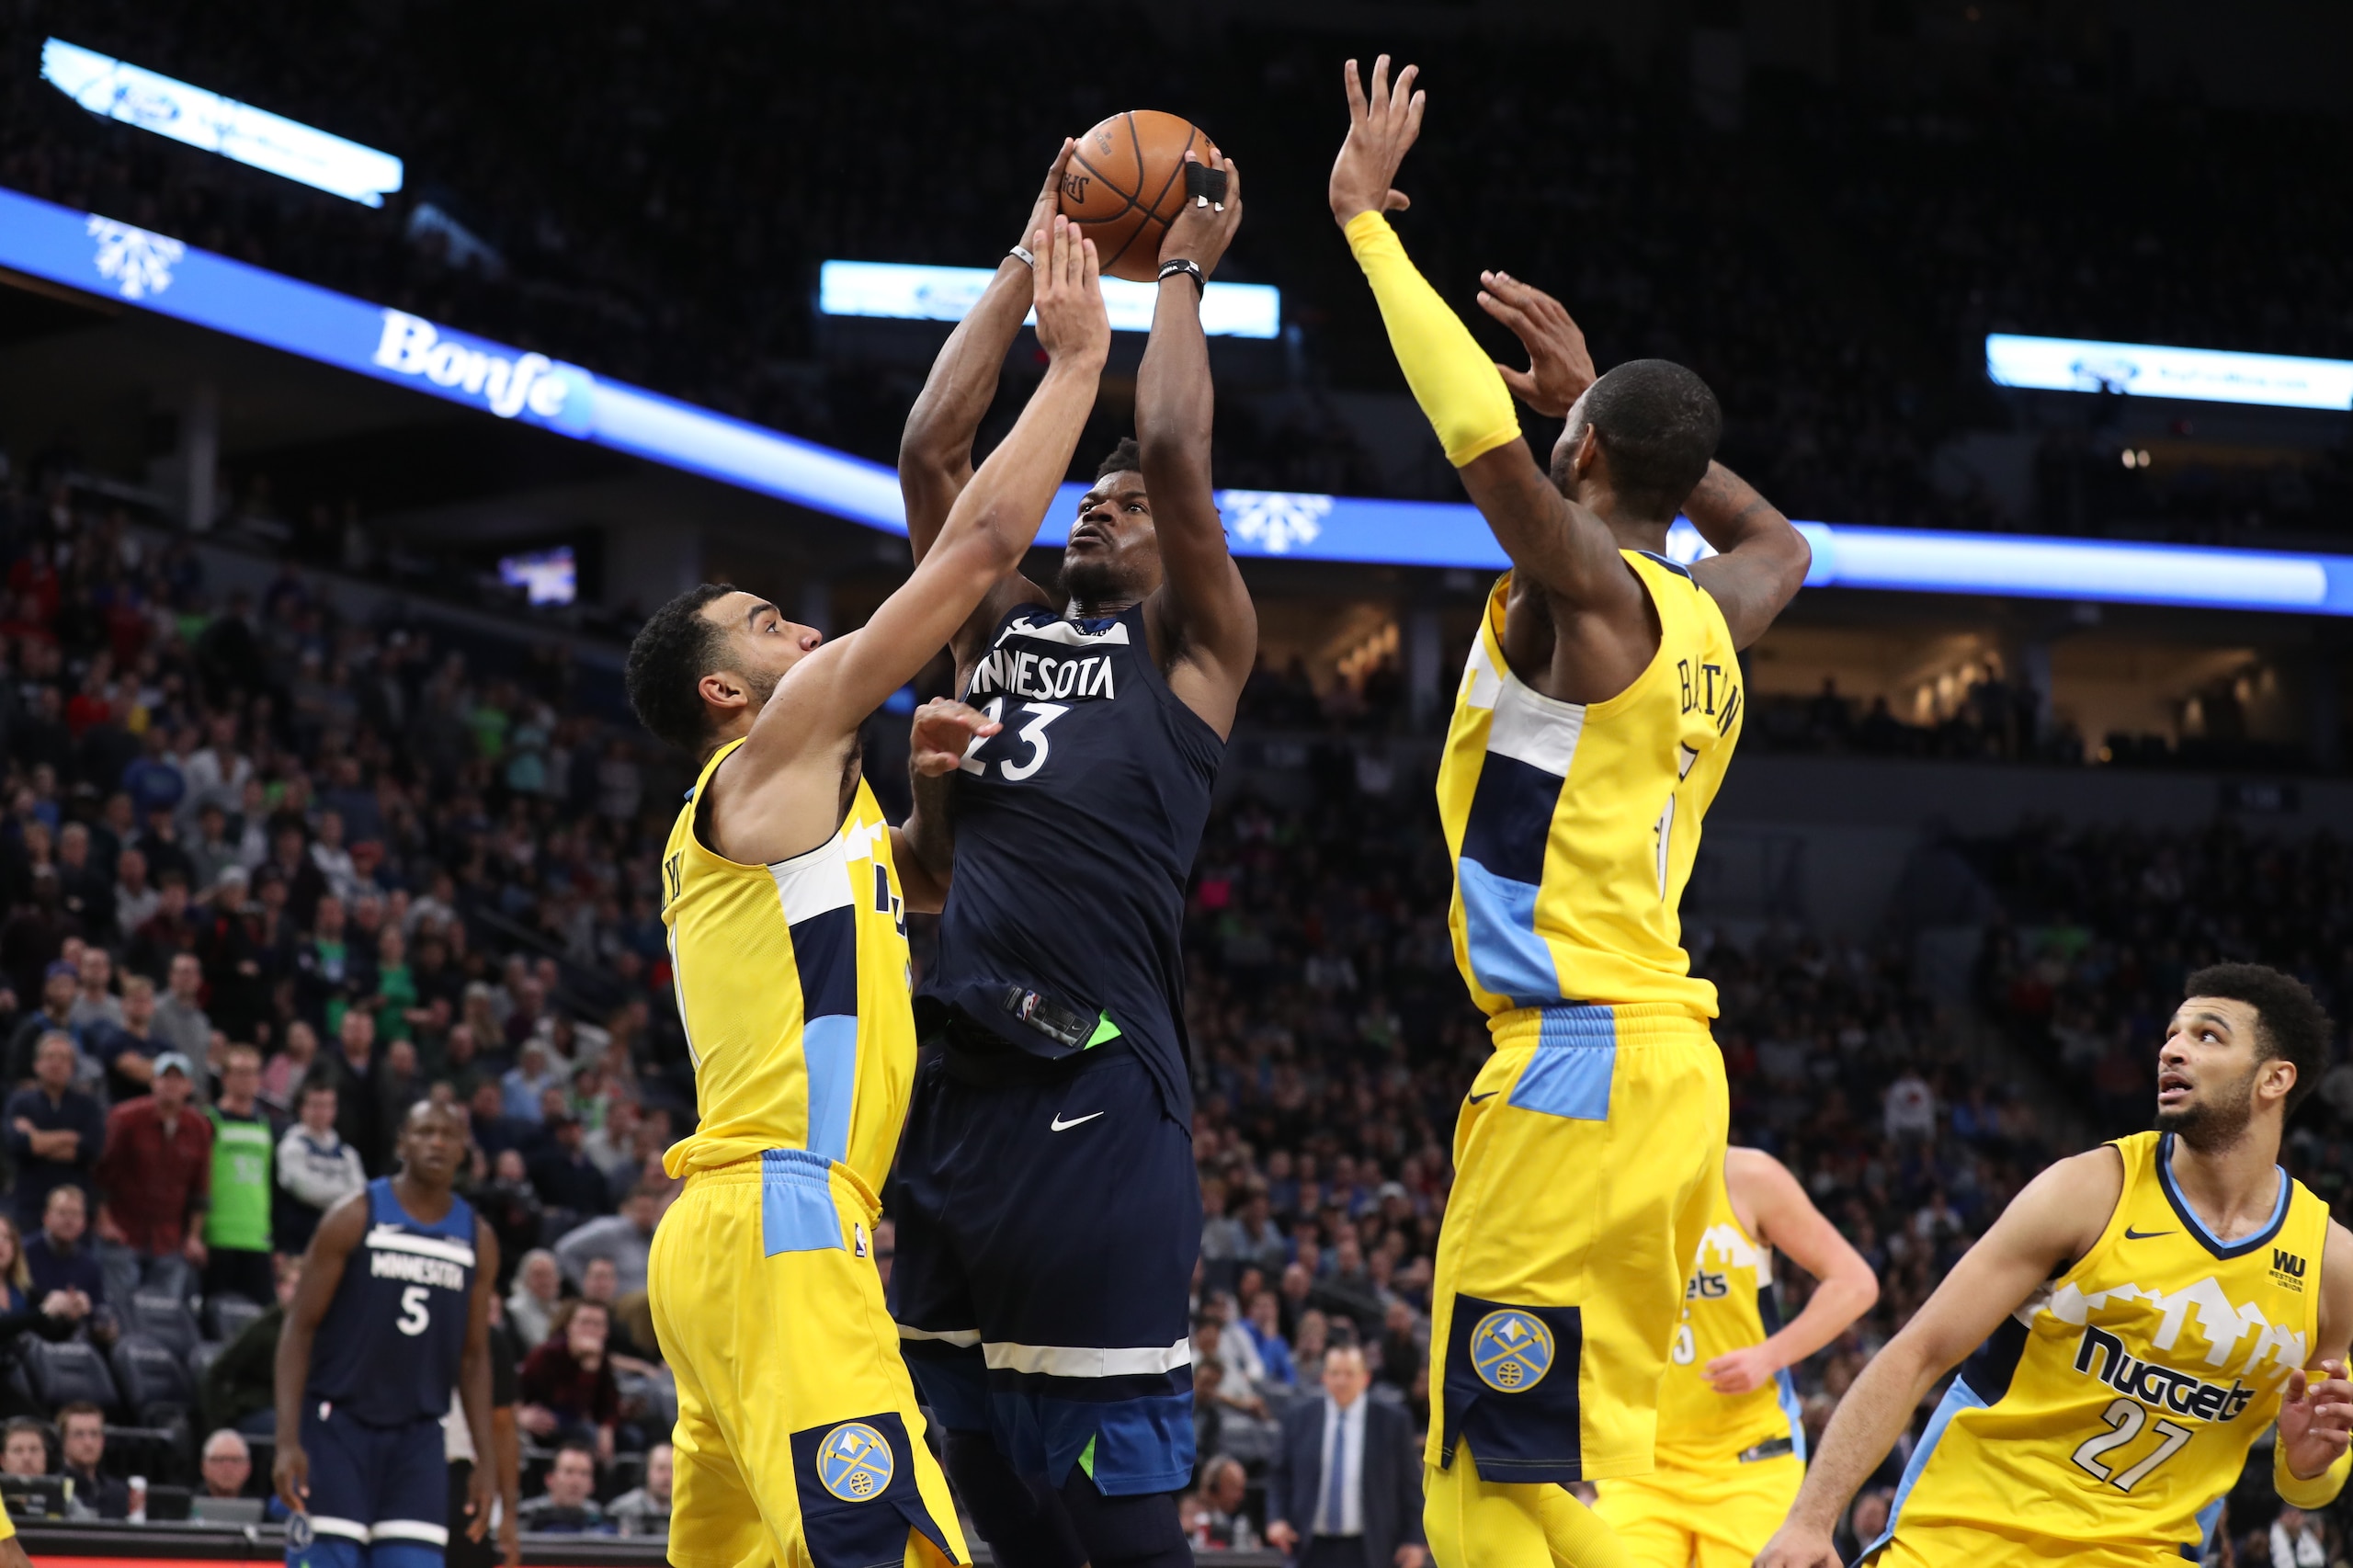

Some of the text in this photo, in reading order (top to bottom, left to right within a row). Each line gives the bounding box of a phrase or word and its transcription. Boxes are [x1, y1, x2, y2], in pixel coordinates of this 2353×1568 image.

[372, 307, 568, 418] Bonfe
[960, 696, 1071, 781] 23
[369, 1251, 463, 1291] MINNESOTA
[2268, 1269, 2303, 1287] WESTERN
[2273, 1247, 2306, 1278] WU
[2277, 1279, 2303, 1293] UNION
[395, 1287, 431, 1336] 5
[1672, 1306, 1698, 1367] 5
[2071, 1397, 2195, 1494] 27
